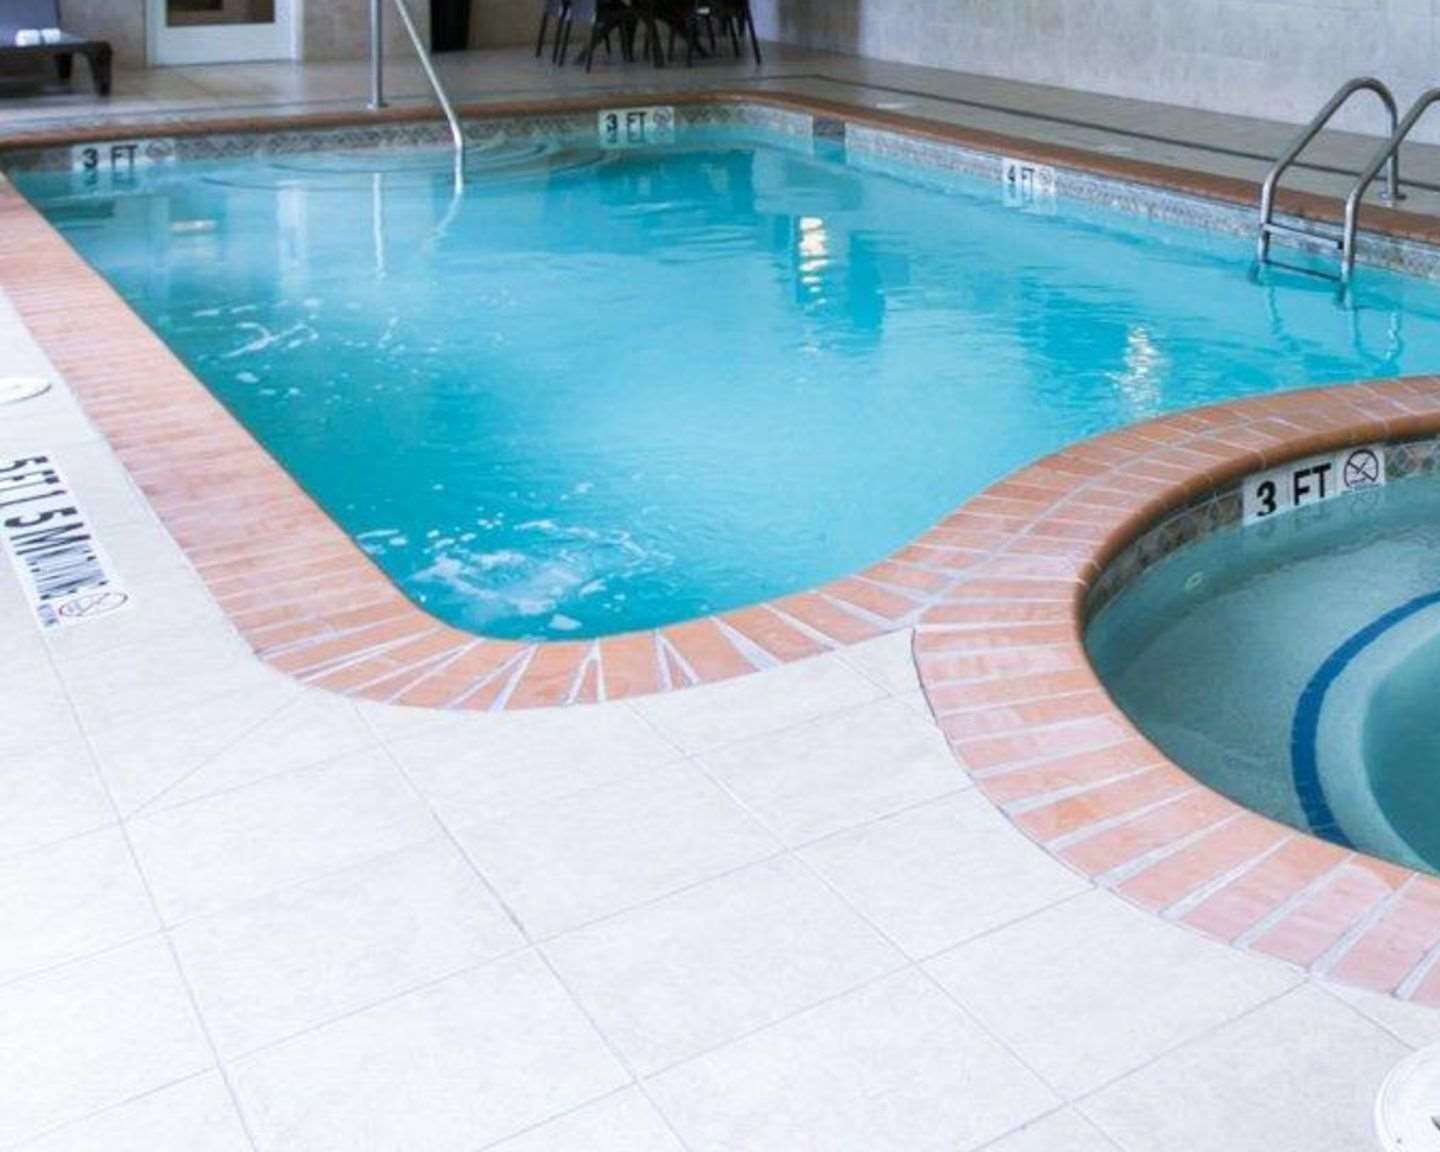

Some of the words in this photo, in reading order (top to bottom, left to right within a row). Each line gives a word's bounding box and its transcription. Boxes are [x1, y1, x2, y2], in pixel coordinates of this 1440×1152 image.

[606, 113, 617, 132] 3
[82, 148, 98, 168] 3
[111, 144, 139, 167] FT
[1256, 480, 1277, 516] 3
[1293, 462, 1332, 506] FT
